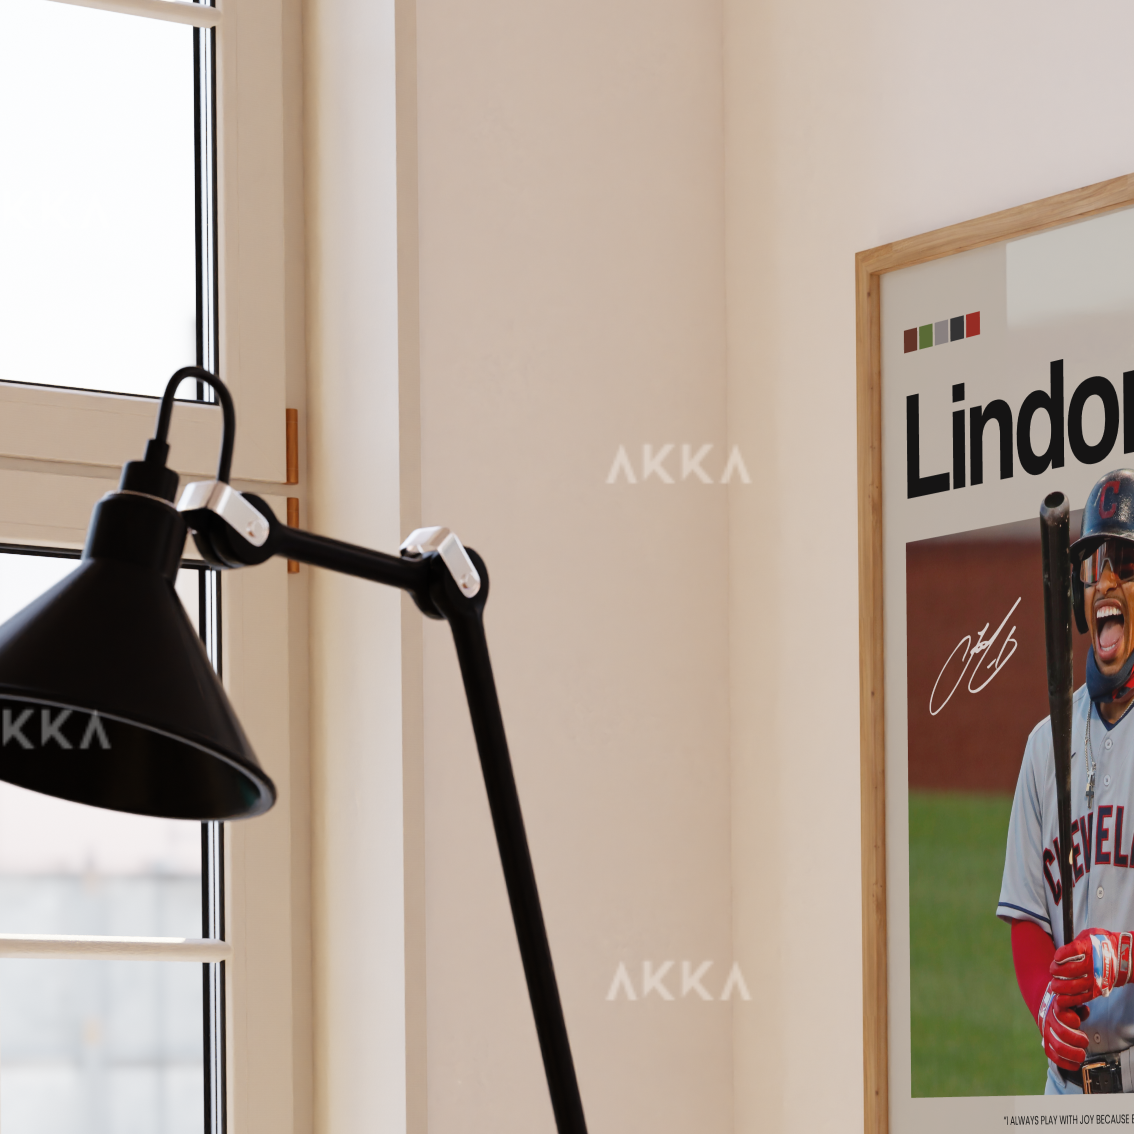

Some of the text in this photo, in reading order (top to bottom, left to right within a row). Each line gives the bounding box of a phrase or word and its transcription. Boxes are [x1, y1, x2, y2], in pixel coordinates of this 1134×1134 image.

[1099, 480, 1121, 519] C
[1010, 1115, 1039, 1126] ALWAYS
[1040, 1115, 1058, 1125] PLAY
[1059, 1115, 1078, 1124] WITH
[1080, 1115, 1094, 1124] JOY
[1096, 1114, 1129, 1124] BECAUSE
